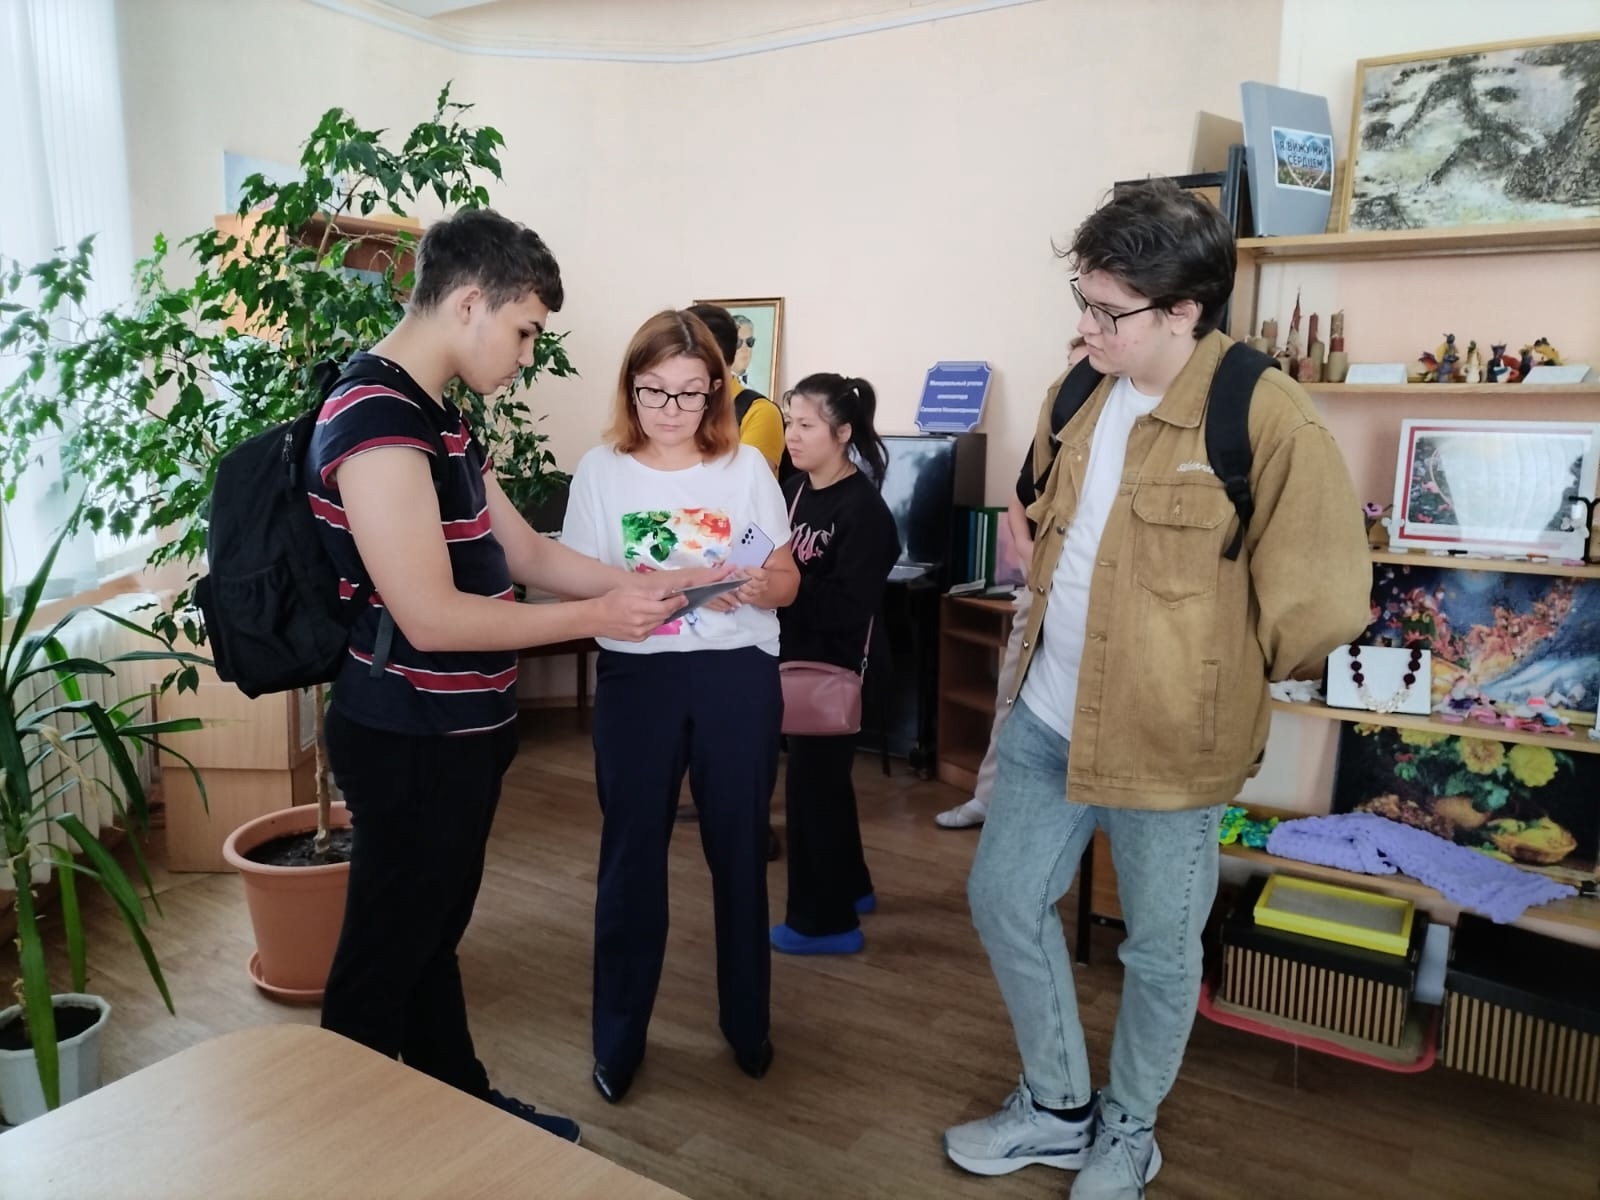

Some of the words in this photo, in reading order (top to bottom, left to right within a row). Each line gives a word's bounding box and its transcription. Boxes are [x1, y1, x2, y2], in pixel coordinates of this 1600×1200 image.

[1287, 141, 1310, 154] ВИЖУ
[1311, 144, 1329, 156] МИР
[1287, 154, 1323, 169] СЕРДЦЕМ
